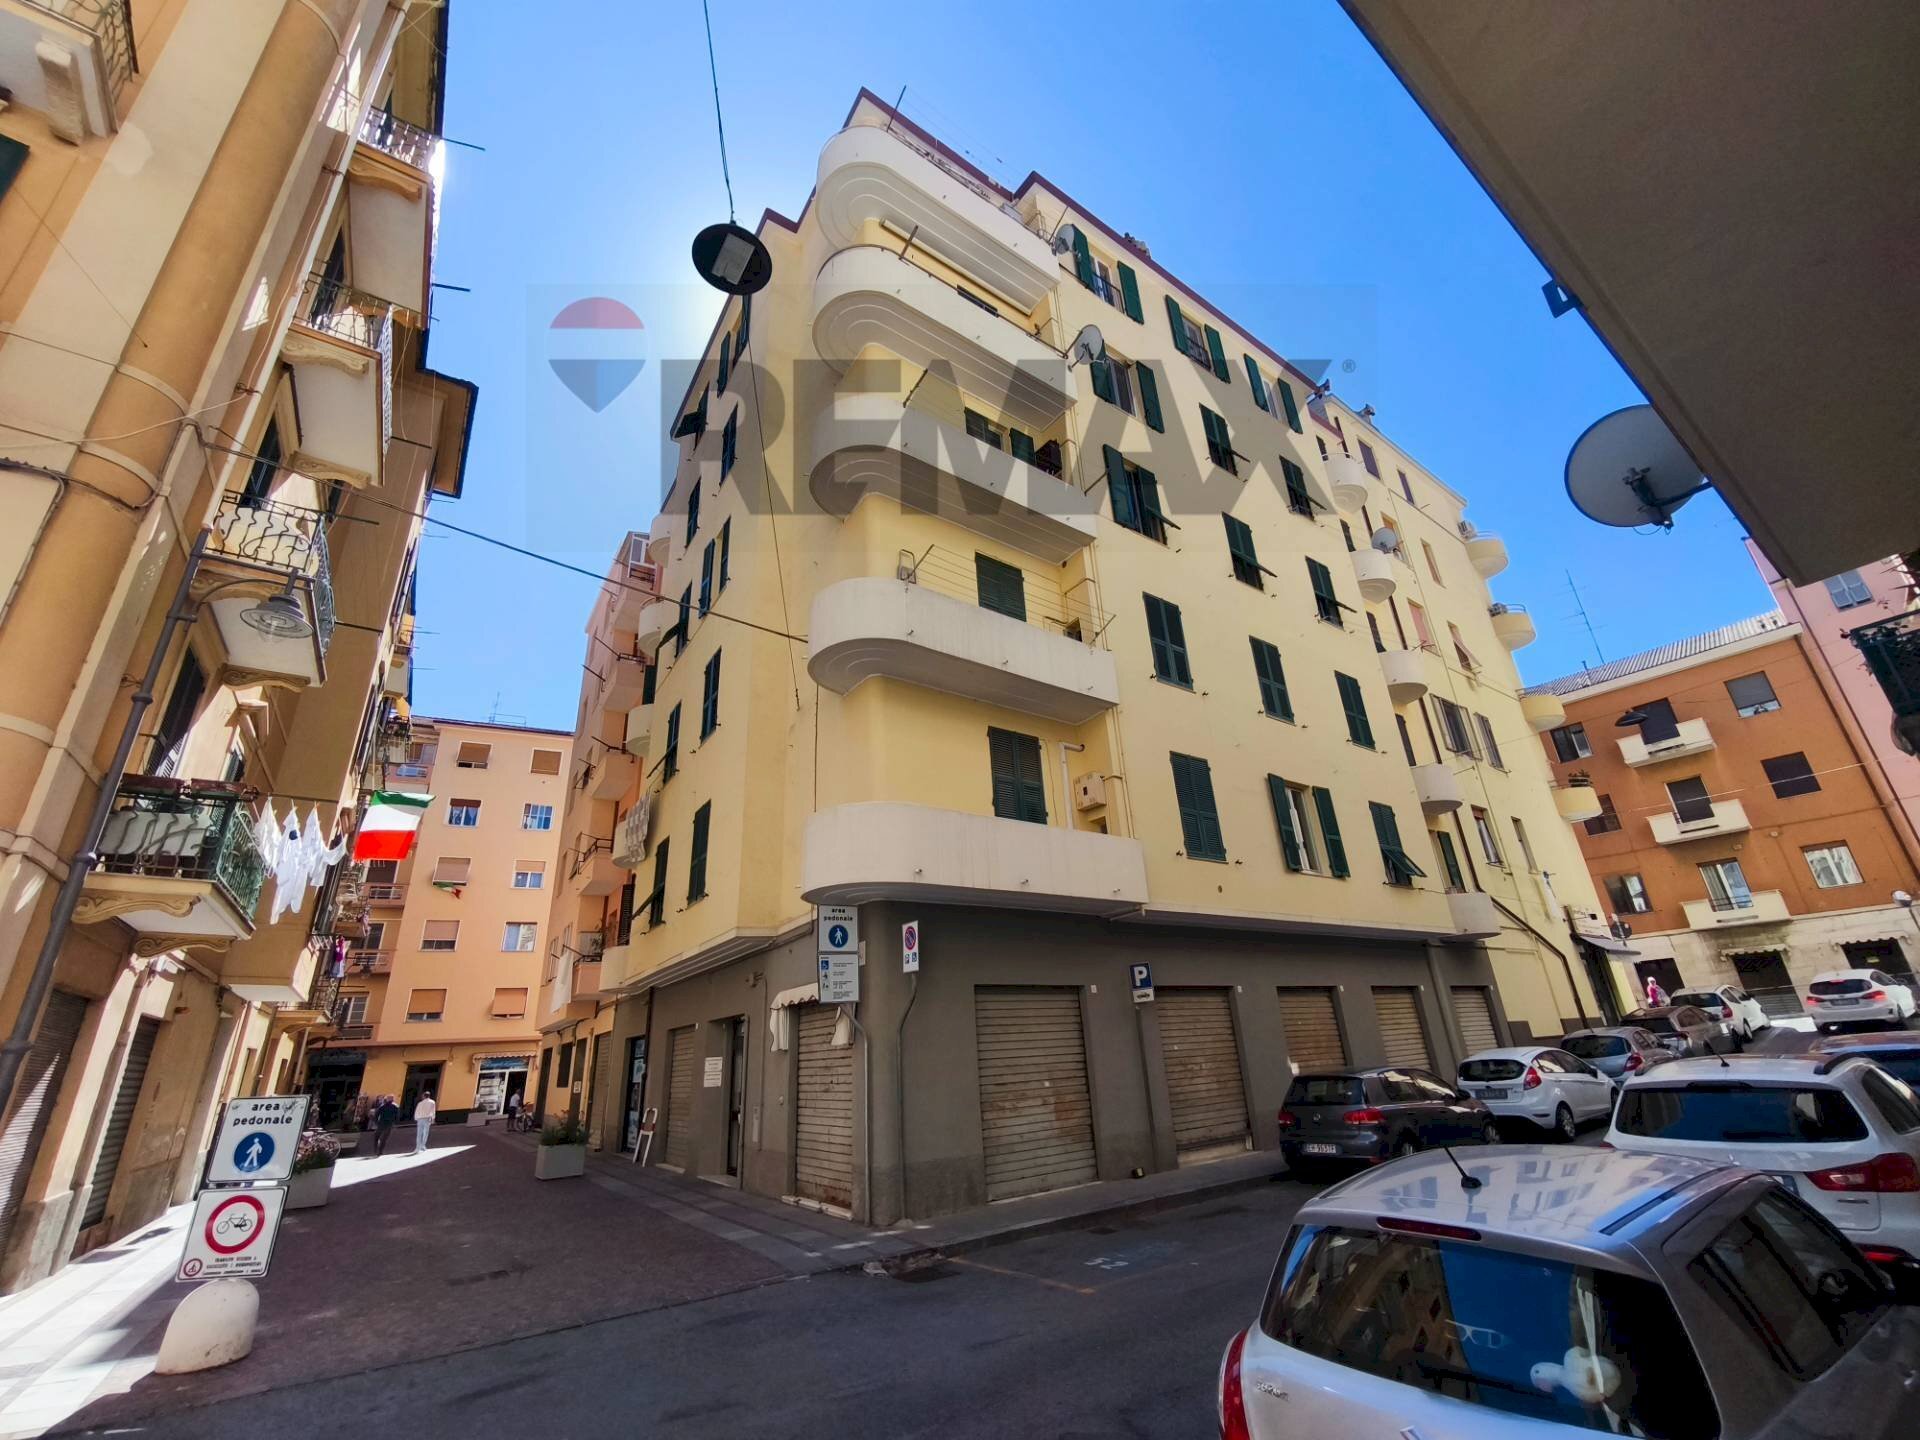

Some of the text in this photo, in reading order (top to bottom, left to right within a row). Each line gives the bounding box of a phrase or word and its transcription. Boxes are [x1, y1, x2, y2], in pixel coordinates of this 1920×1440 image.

[1133, 966, 1148, 987] P
[251, 1103, 280, 1112] area
[232, 1114, 293, 1127] pedonale
